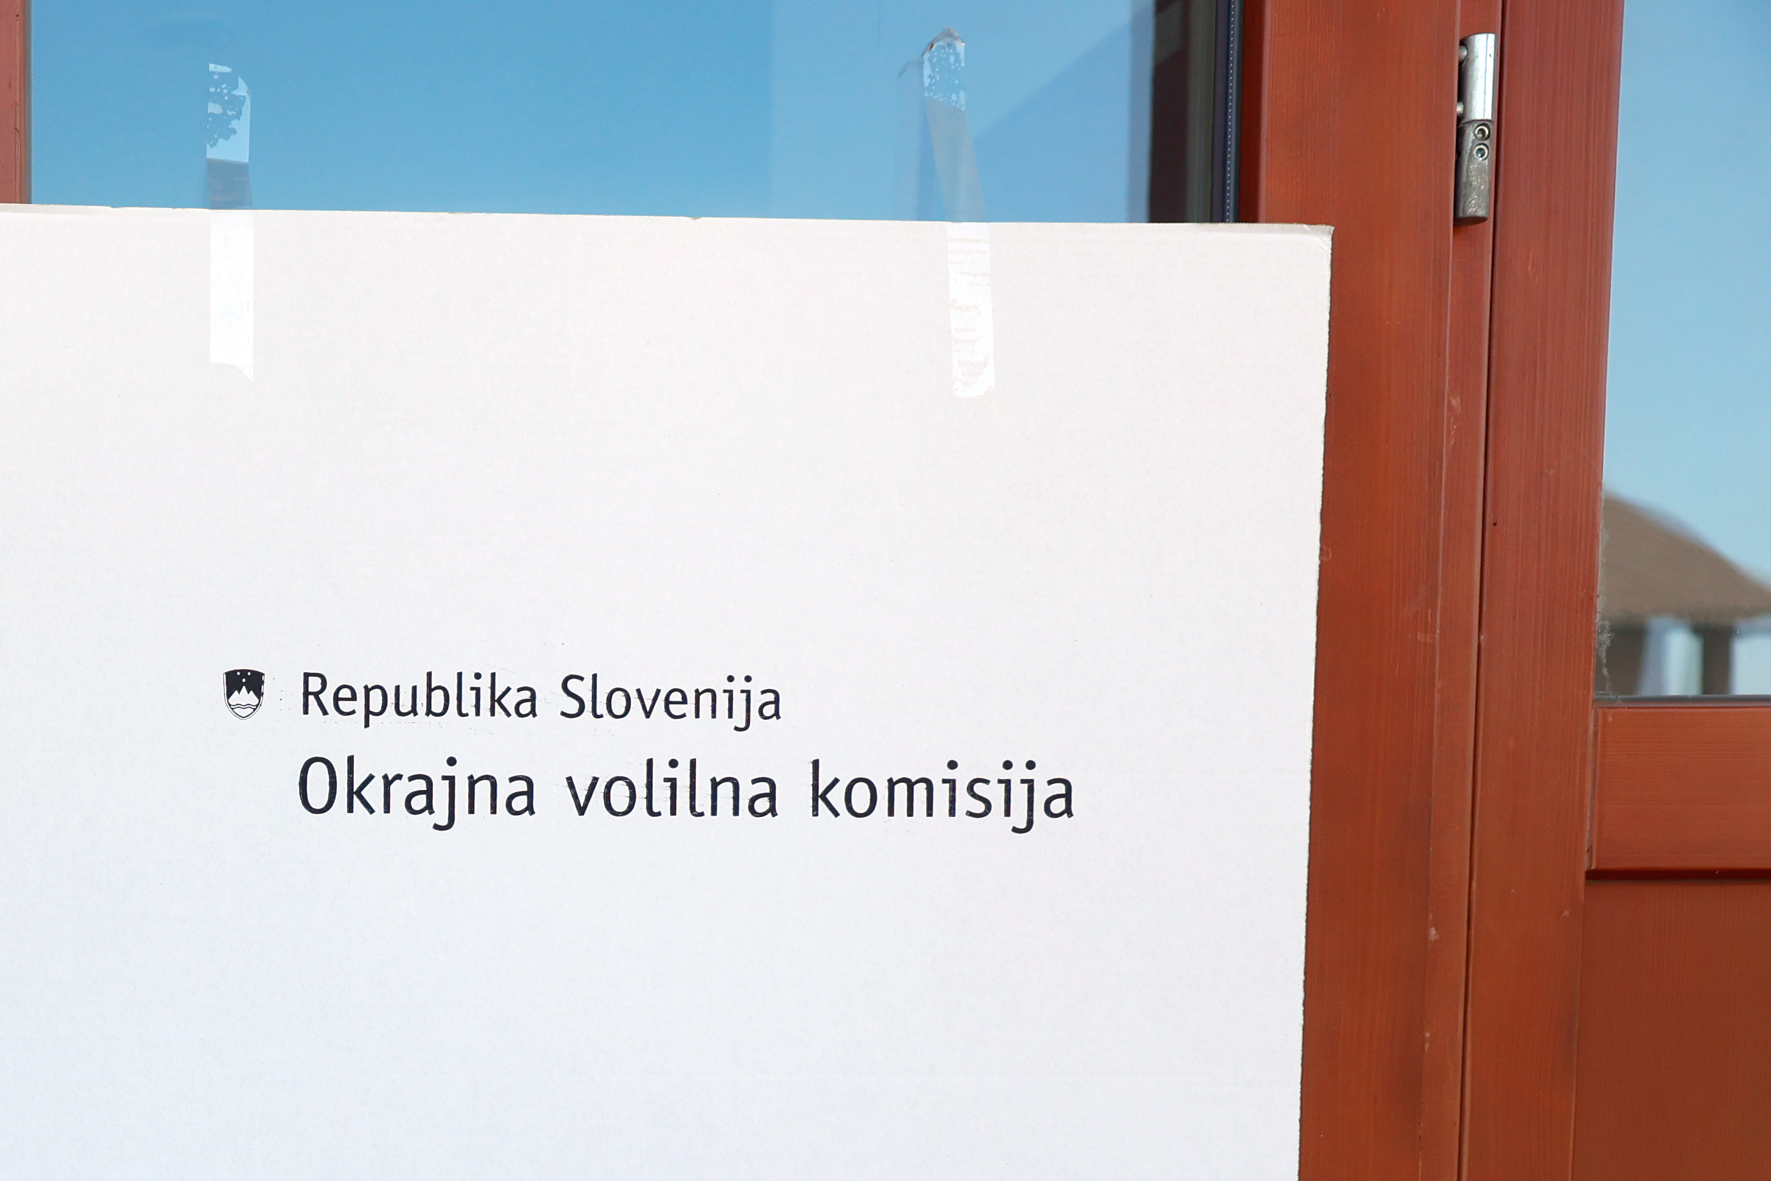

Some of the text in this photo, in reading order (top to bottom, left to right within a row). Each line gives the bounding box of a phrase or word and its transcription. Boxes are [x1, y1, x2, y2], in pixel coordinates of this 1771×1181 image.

[302, 670, 783, 732] Republika Slovenija
[298, 754, 1075, 835] Okrajna volilna komisija
